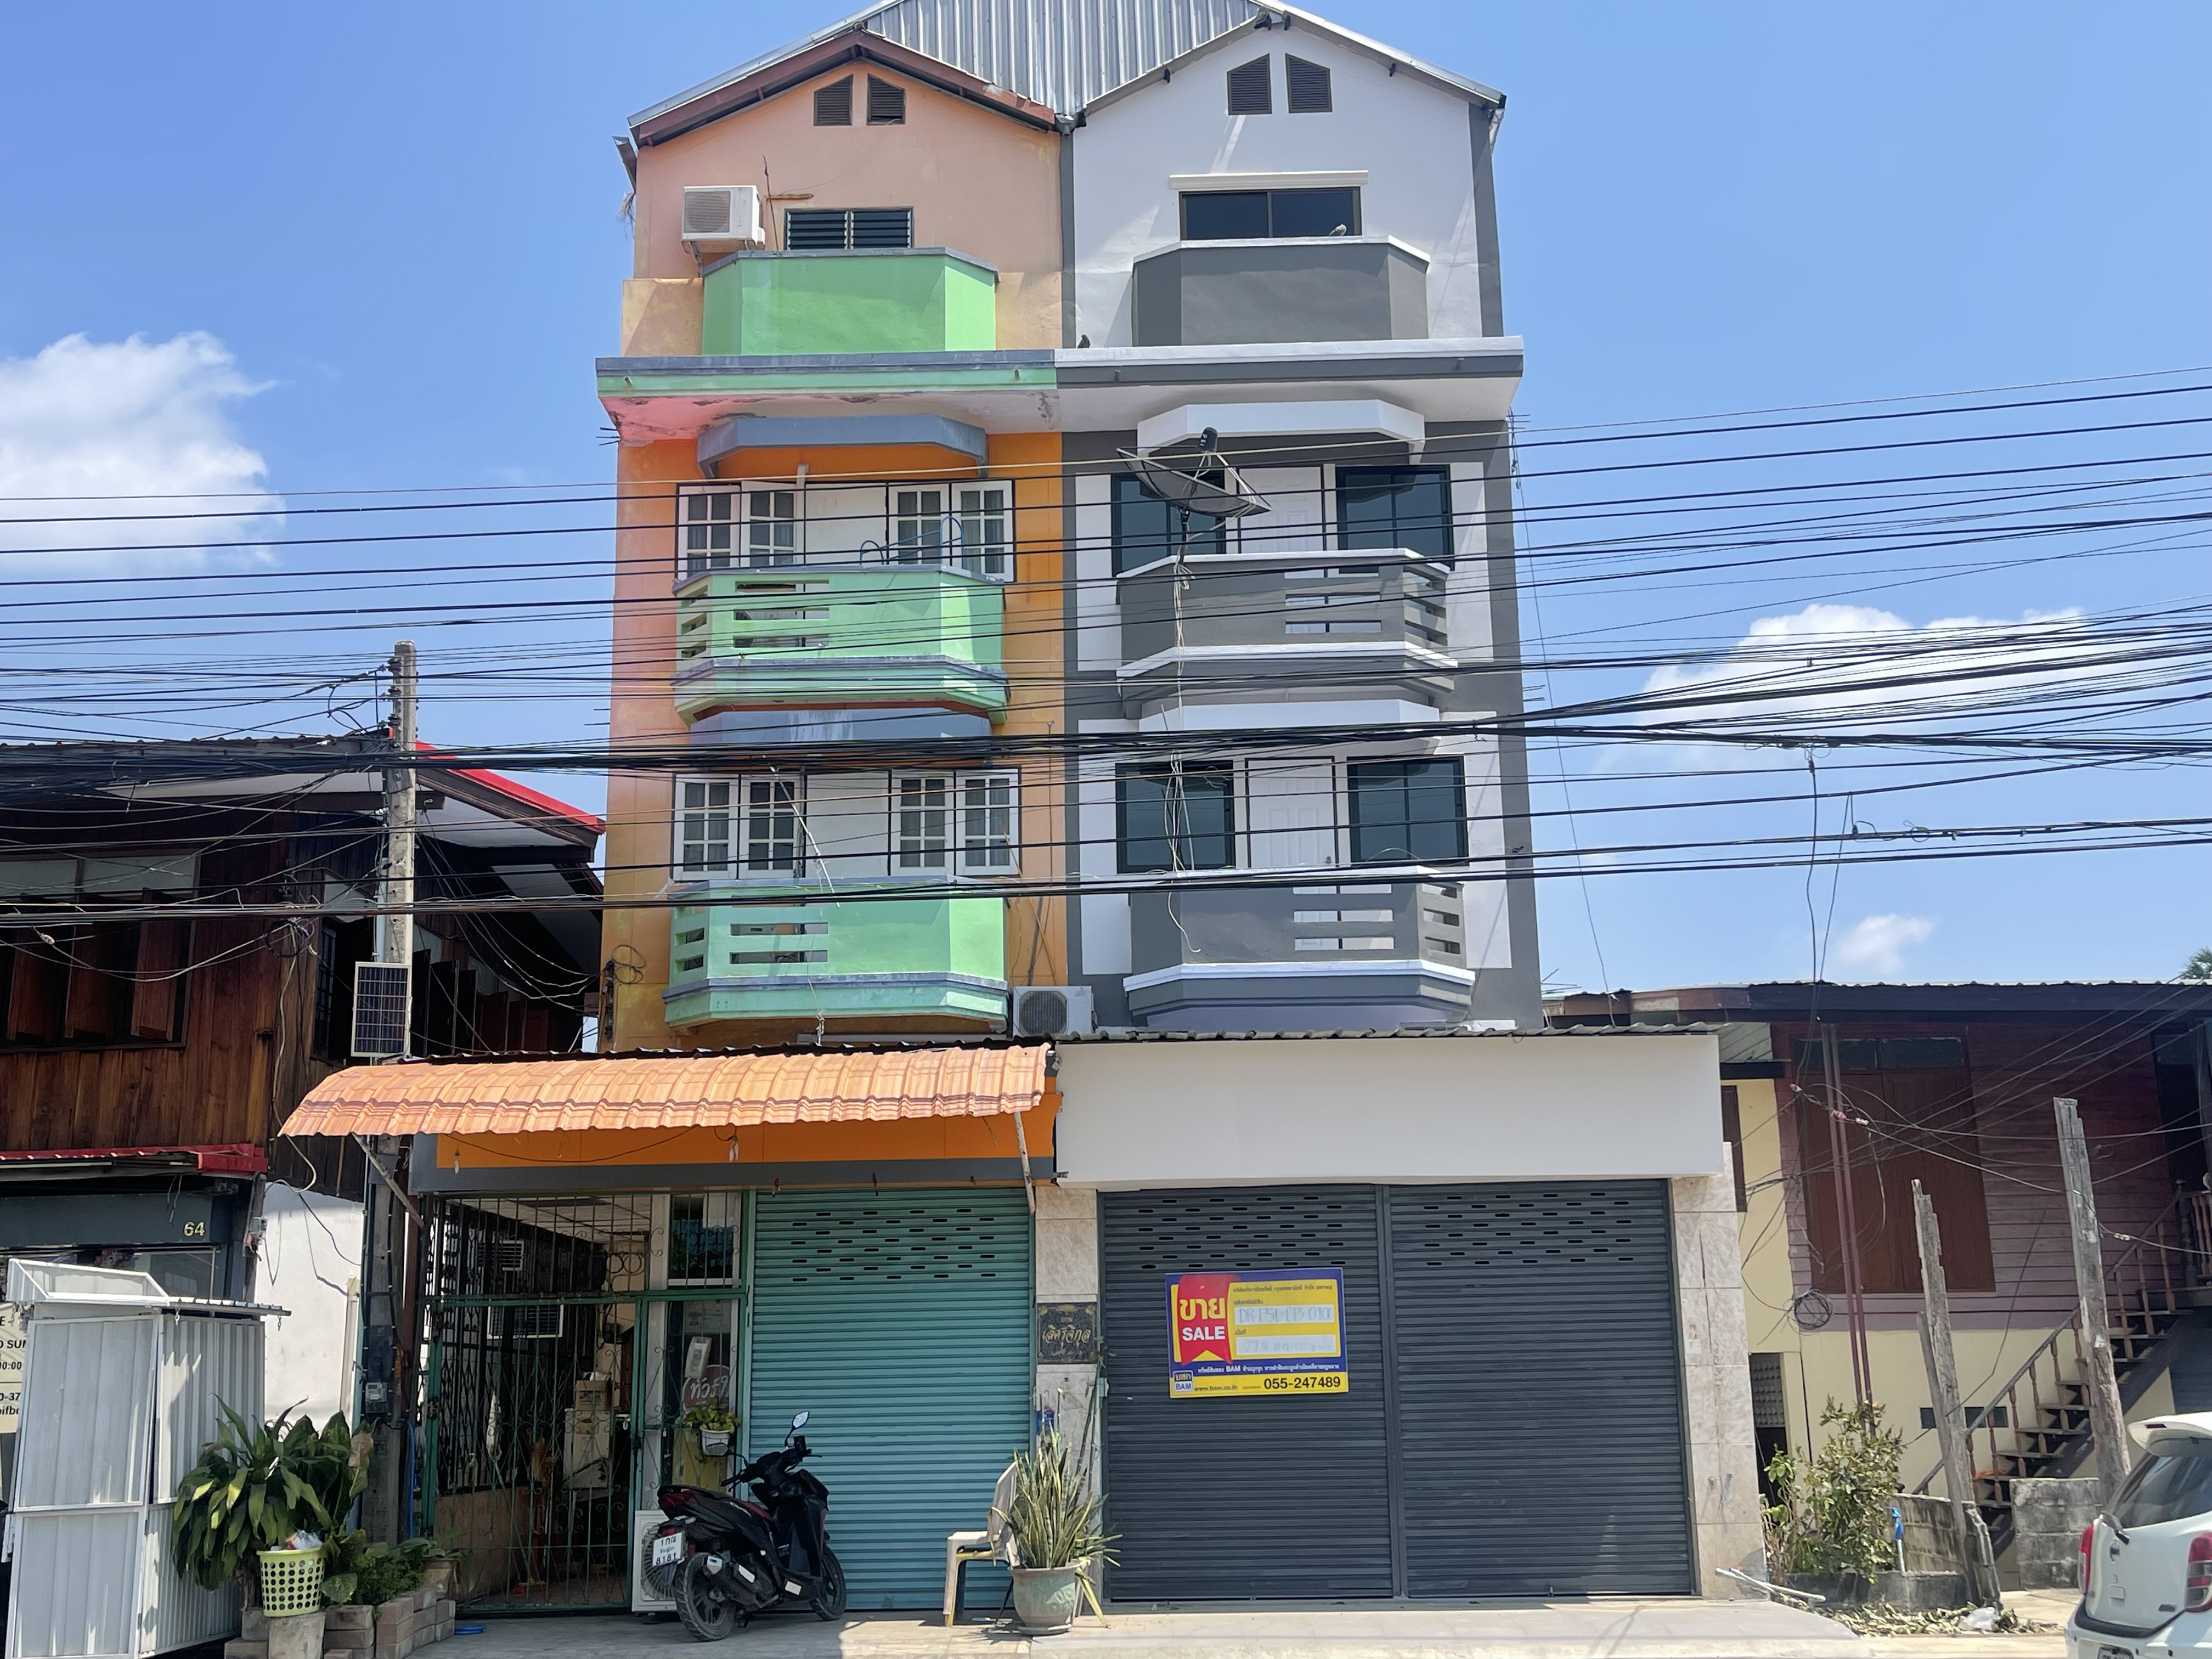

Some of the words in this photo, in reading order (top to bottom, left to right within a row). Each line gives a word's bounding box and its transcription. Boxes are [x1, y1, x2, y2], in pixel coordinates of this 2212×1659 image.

[184, 1221, 205, 1237] 64
[1180, 1297, 1226, 1321] ขาย
[1182, 1325, 1226, 1341] SALE
[1264, 1376, 1340, 1389] 055-247489
